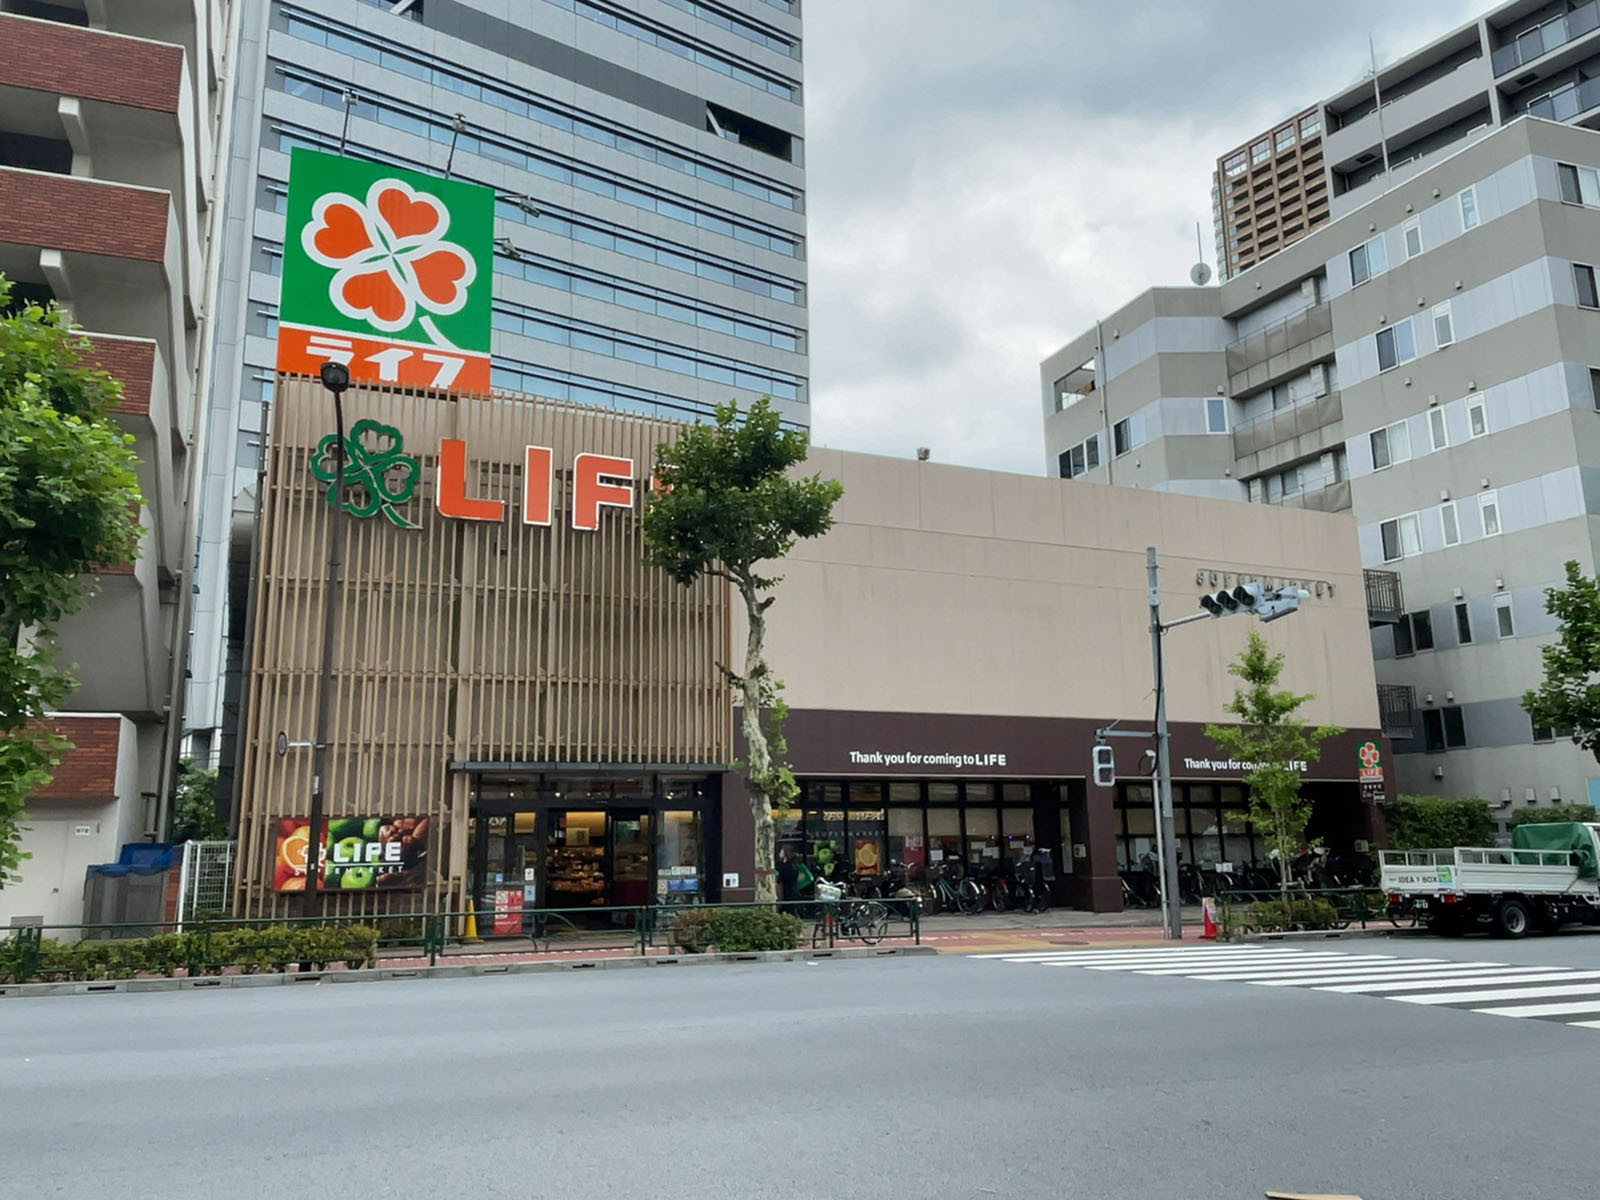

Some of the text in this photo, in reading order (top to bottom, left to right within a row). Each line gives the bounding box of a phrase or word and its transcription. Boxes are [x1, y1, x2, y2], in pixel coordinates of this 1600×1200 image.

[306, 335, 465, 389] ライフ
[436, 438, 678, 531] LIF
[849, 751, 1007, 768] Thank you for coming to LIFE
[1183, 758, 1211, 769] Thank
[1211, 760, 1227, 771] you
[1228, 758, 1241, 769] for
[333, 841, 403, 863] LIFE
